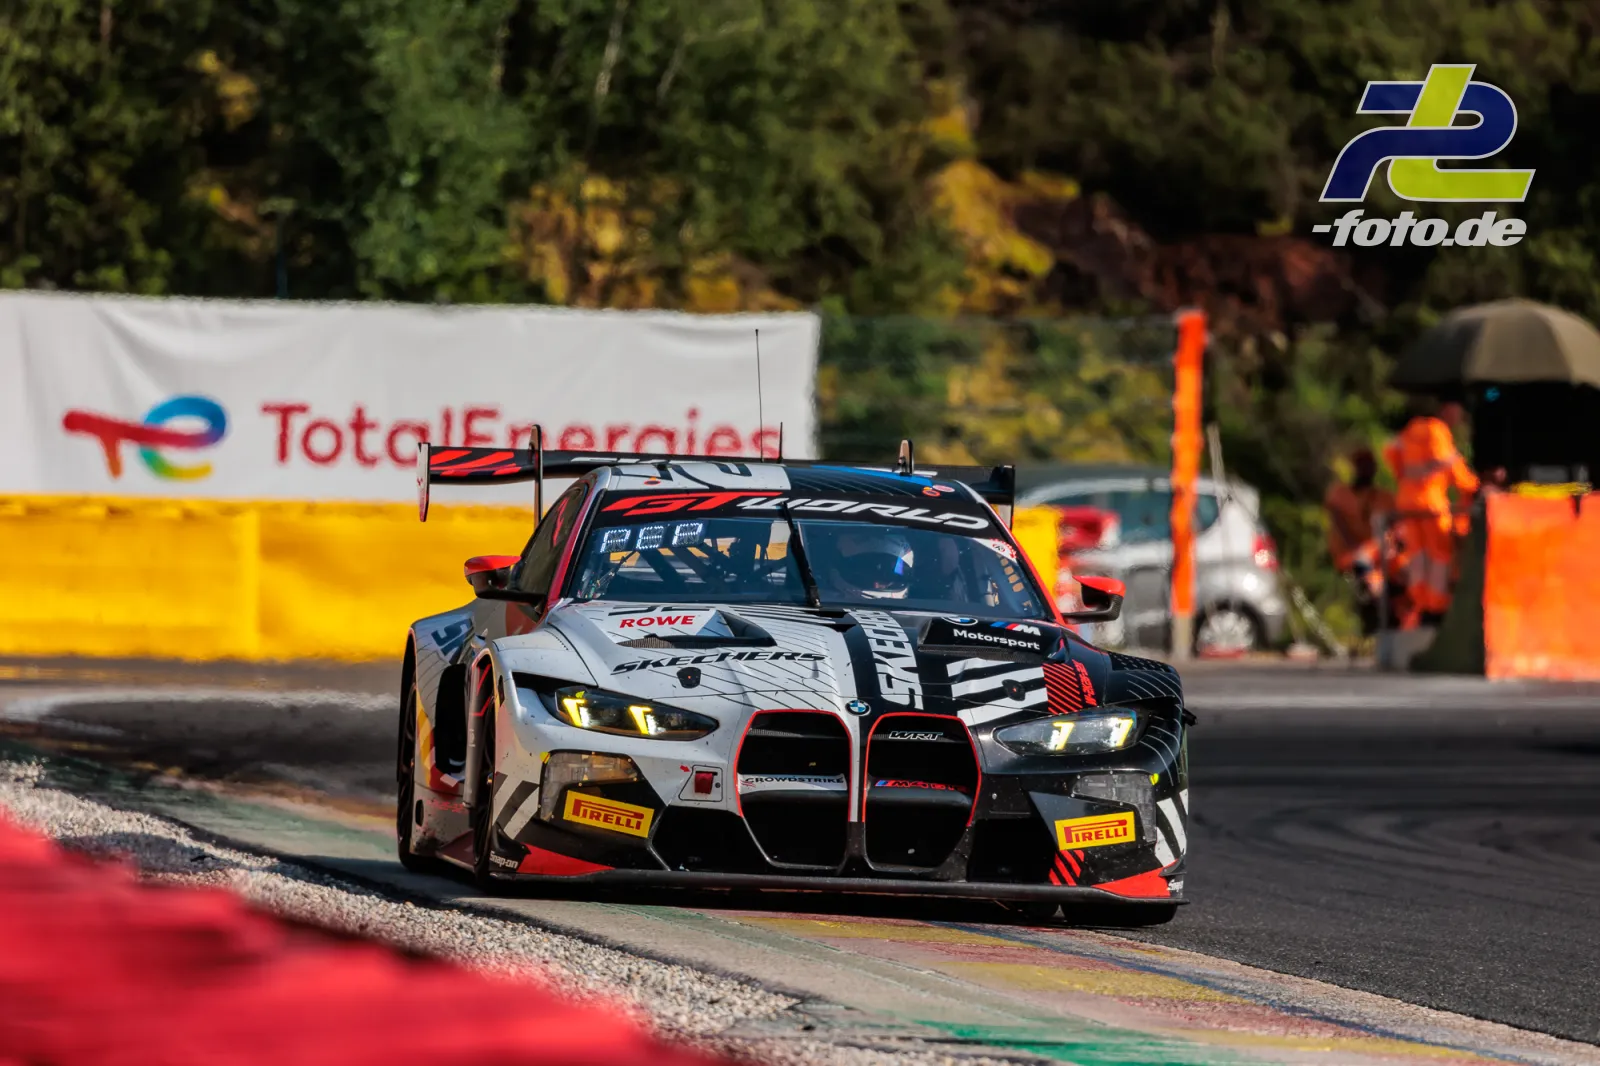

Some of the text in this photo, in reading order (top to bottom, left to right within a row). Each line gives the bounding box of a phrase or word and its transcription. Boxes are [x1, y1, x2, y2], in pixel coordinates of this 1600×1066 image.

[600, 522, 703, 553] PEP
[619, 615, 696, 628] ROWE
[953, 628, 1041, 650] Motorsport
[610, 651, 826, 676] SKECHERS
[888, 730, 944, 741] WRT
[745, 776, 844, 784] CROWDSTRIKE
[571, 798, 645, 830] PIRELLI
[1063, 819, 1128, 844] PIRELLI
[489, 850, 519, 869] Snap-on
